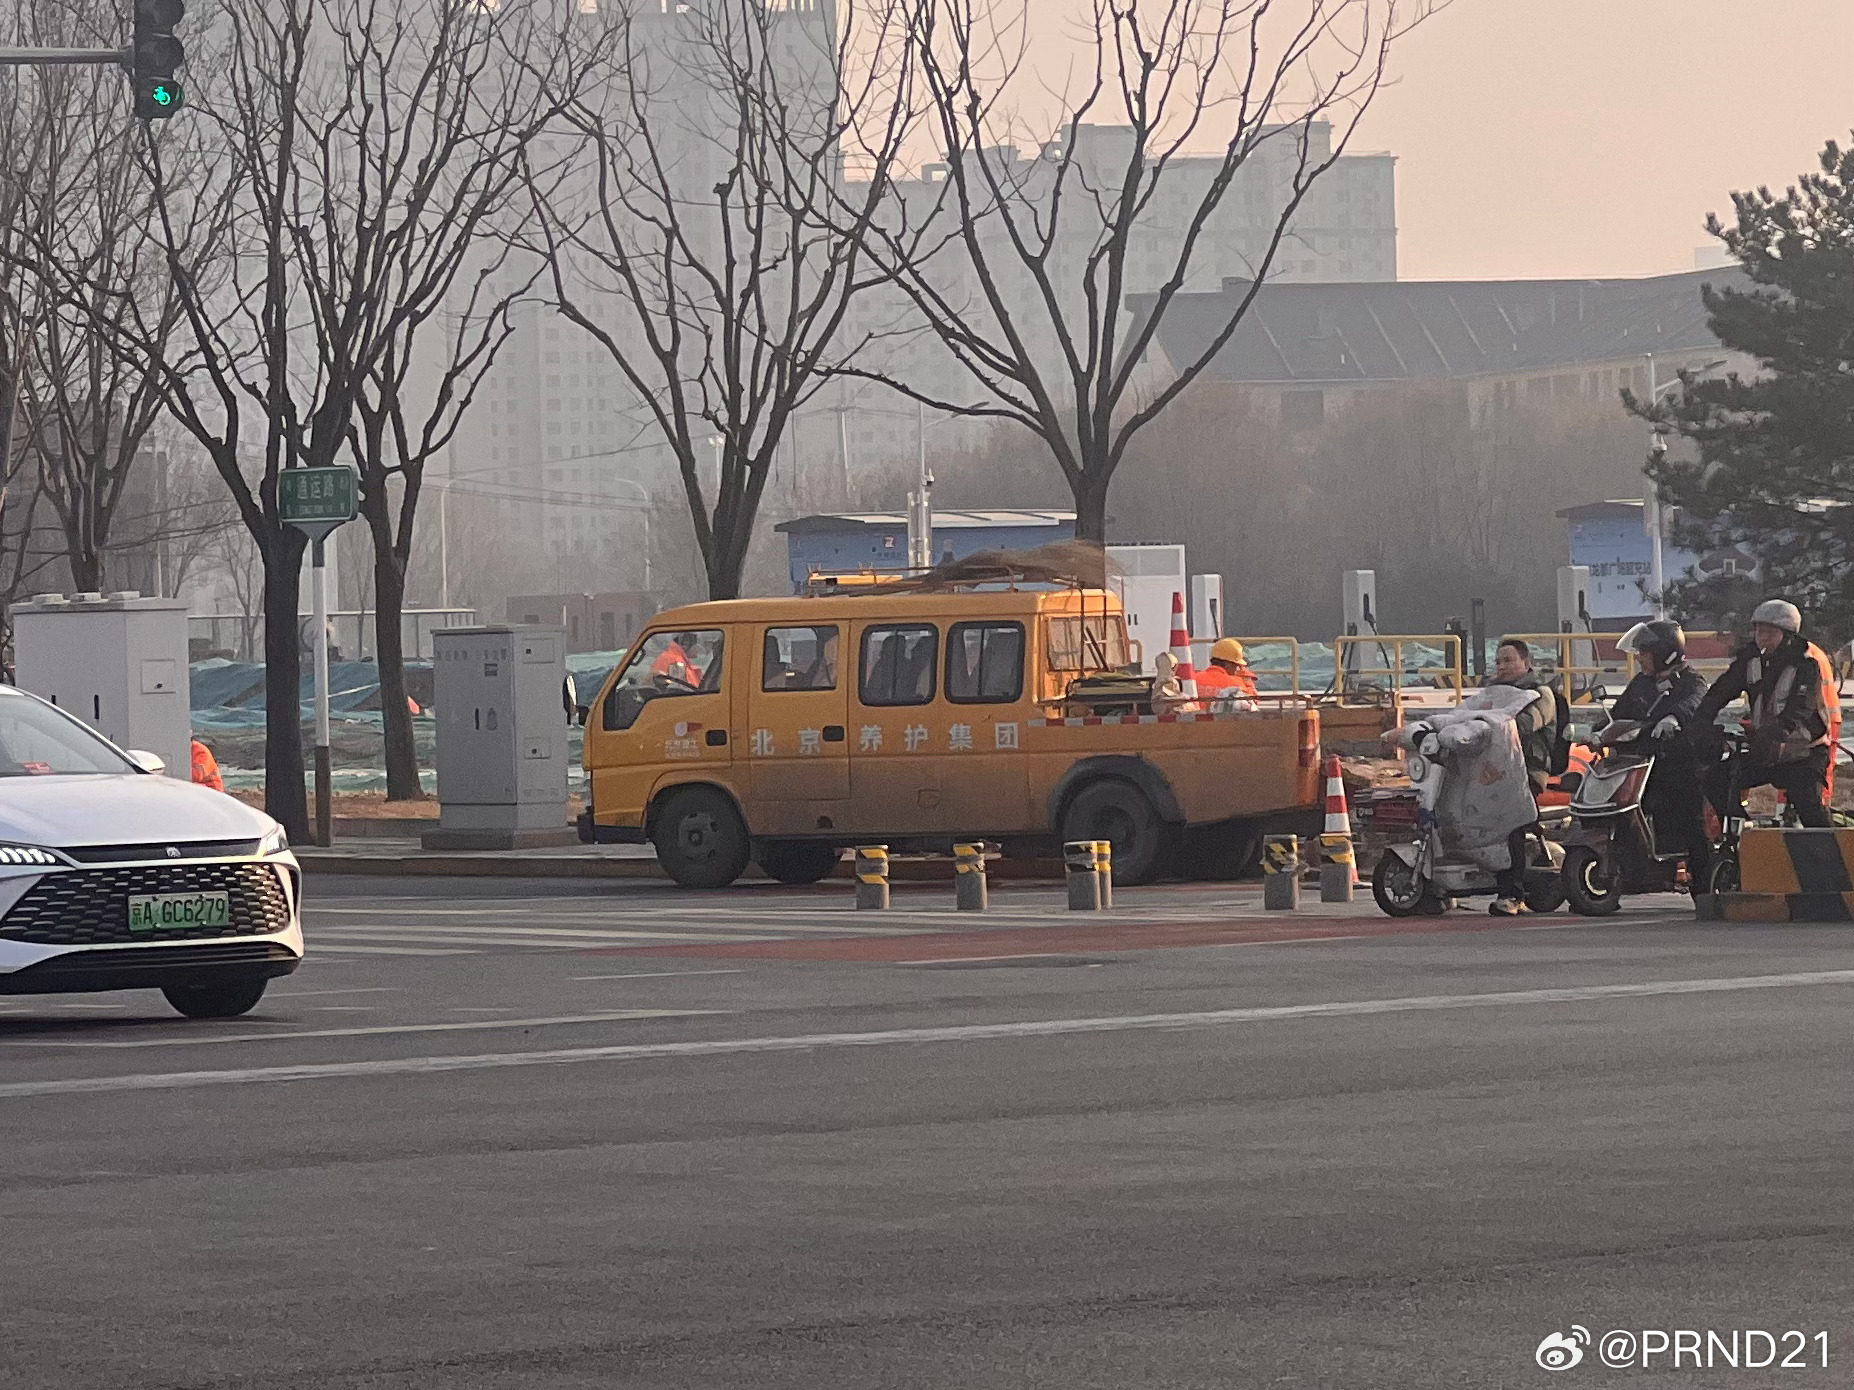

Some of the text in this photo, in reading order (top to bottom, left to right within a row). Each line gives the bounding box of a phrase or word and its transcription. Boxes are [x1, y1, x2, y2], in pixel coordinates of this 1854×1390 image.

[297, 473, 334, 500] 通运路
[751, 722, 1019, 756] 北京养护集团
